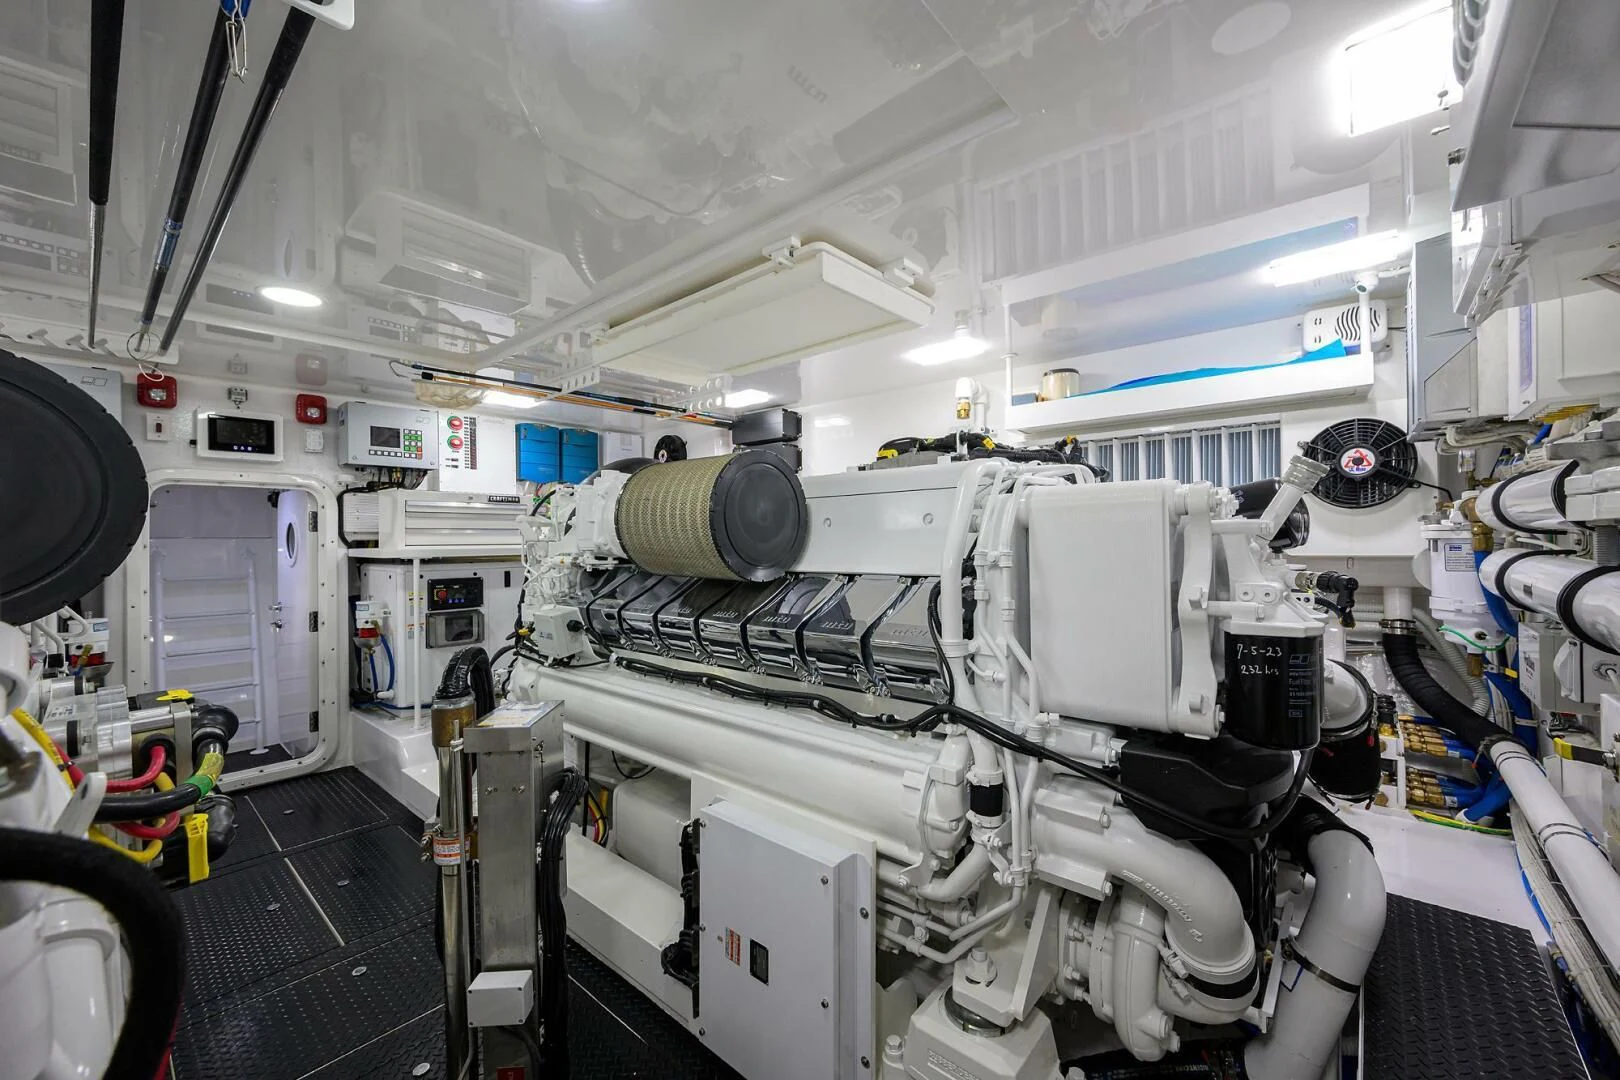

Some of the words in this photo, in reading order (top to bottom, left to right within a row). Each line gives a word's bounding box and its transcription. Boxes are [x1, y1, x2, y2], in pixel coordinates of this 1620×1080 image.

[1237, 643, 1282, 659] 7-5-23
[1241, 664, 1262, 674] 232
[1265, 664, 1279, 675] hrs
